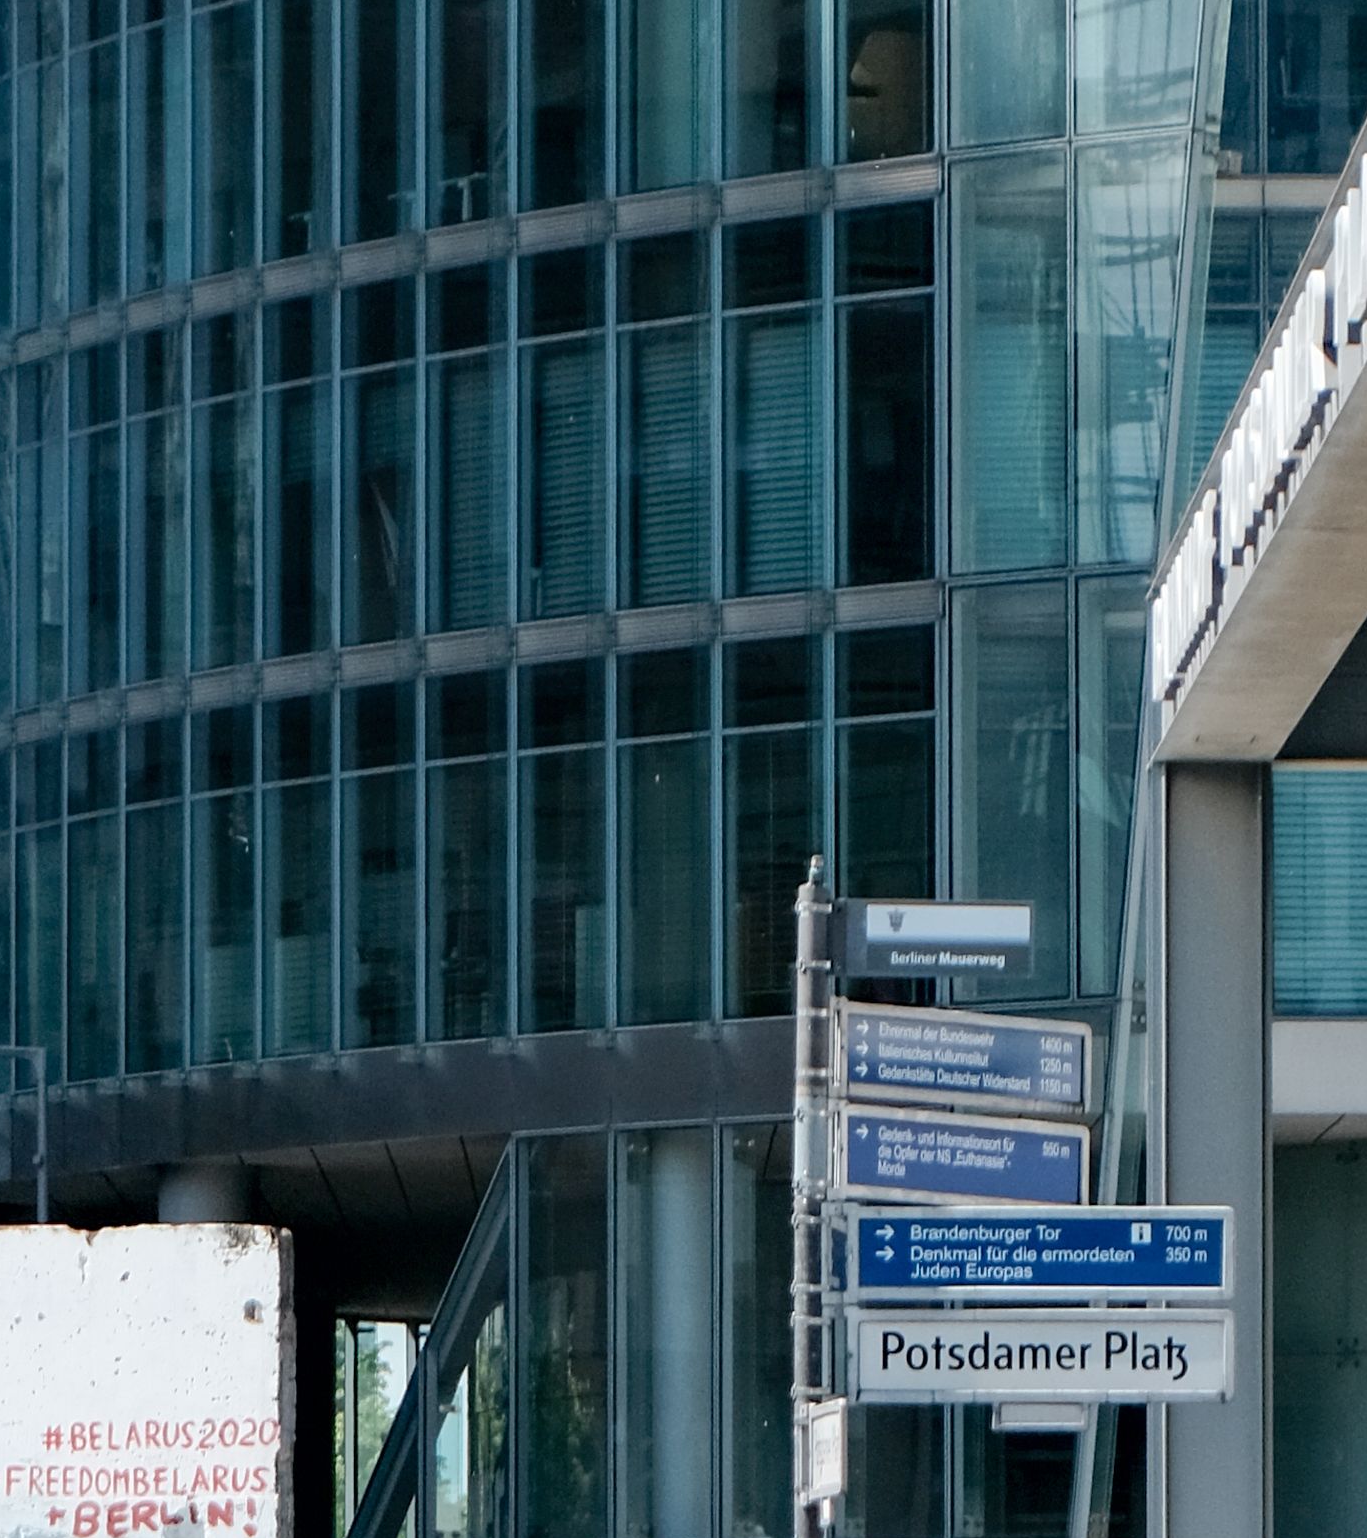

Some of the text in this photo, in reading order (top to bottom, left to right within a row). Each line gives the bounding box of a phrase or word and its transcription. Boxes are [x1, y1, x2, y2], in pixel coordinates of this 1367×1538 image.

[890, 951, 1005, 969] Berliner Mauerweg
[878, 1021, 922, 1040] Ehrenmal
[923, 1025, 938, 1041] der
[940, 1026, 995, 1046] Bundeswehr
[1063, 1041, 1073, 1054] m
[878, 1043, 932, 1062] Italienisches
[1040, 1057, 1061, 1073] 1250
[1063, 1063, 1072, 1074] m
[878, 1064, 1071, 1095] Gedenkstätte Deutscher Widerstand 1150 m
[878, 1124, 916, 1143] Gedenk-
[918, 1130, 935, 1146] und
[937, 1131, 1001, 1152] Informationsort
[1003, 1137, 1016, 1153] für
[1060, 1145, 1070, 1159] m
[878, 1145, 892, 1160] die
[893, 1145, 919, 1164] Opfer
[920, 1148, 935, 1164] der
[937, 1149, 951, 1164] NS
[877, 1161, 906, 1176] Morde
[910, 1225, 1032, 1244] Brandenburger
[1035, 1225, 1061, 1241] Tor
[1165, 1225, 1191, 1241] 700
[1194, 1229, 1208, 1241] m
[910, 1246, 1208, 1263] Denkmal für die ermordeten 350 m
[910, 1263, 1034, 1282] Juden Europas
[881, 1330, 1189, 1381] Potsdamer Platz
[41, 1417, 280, 1452] #BELARUS2020
